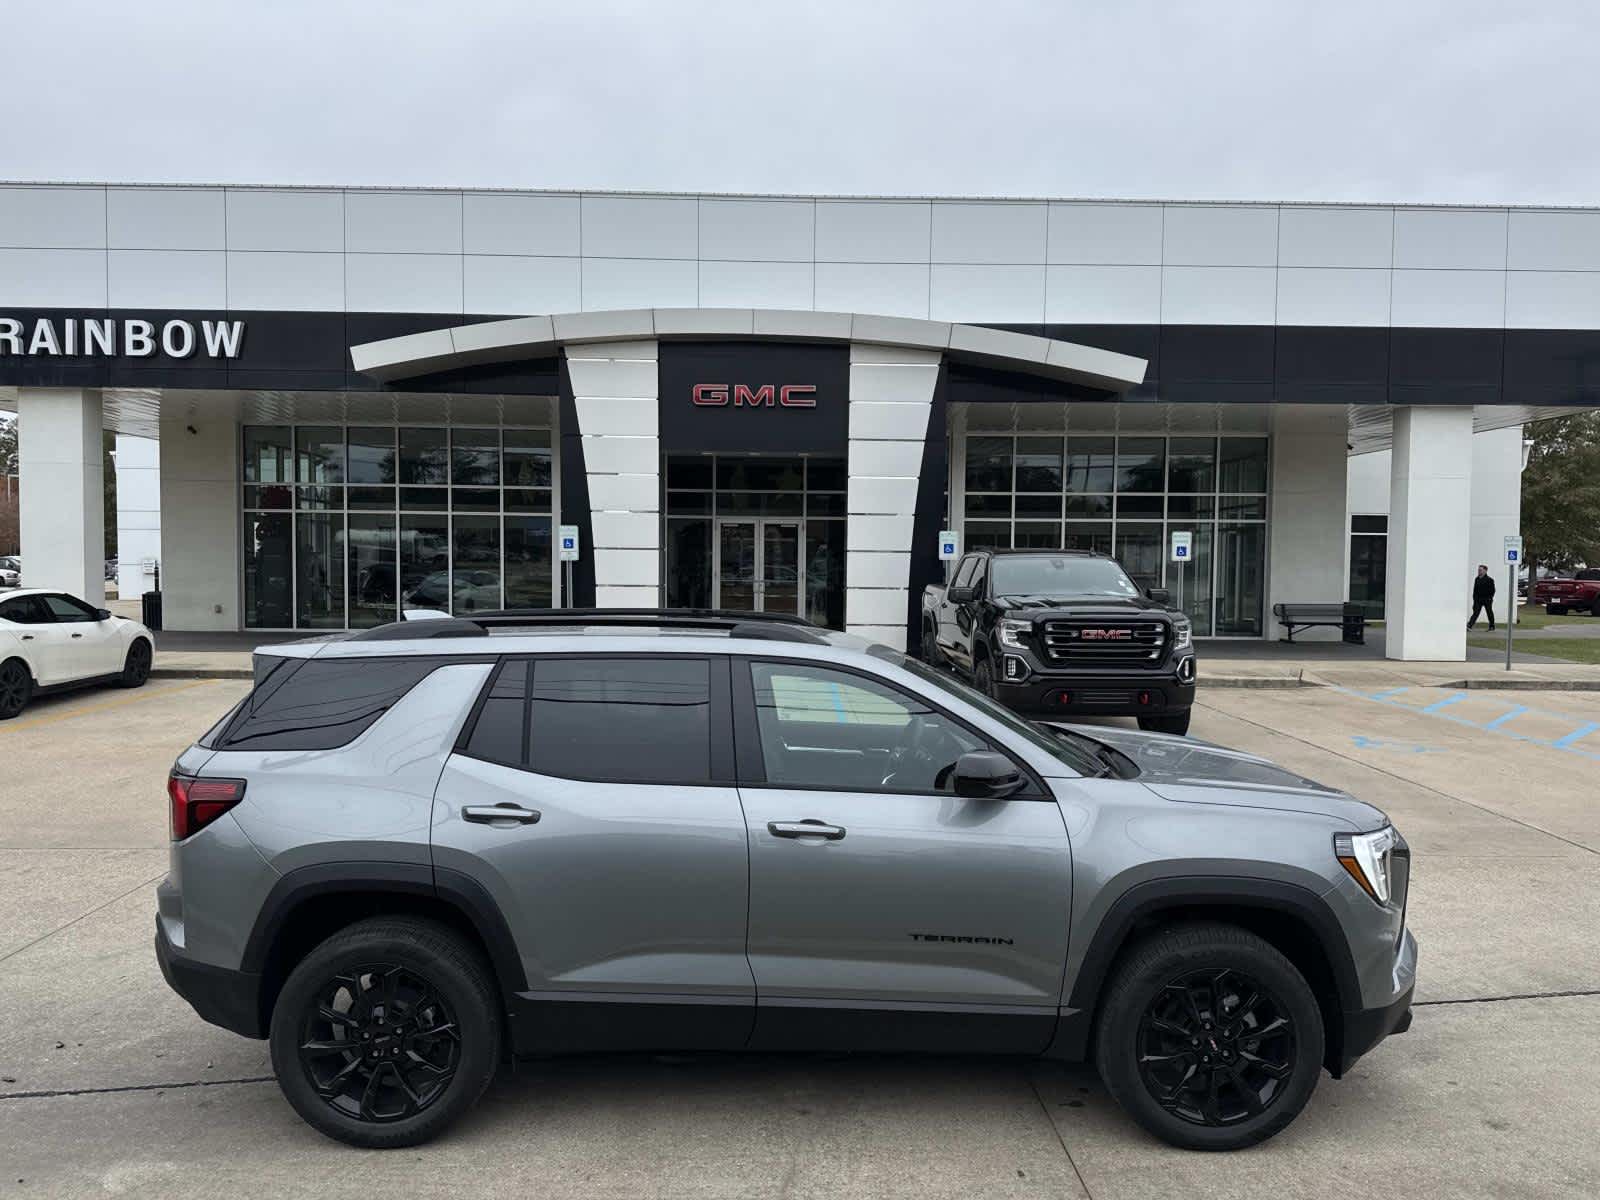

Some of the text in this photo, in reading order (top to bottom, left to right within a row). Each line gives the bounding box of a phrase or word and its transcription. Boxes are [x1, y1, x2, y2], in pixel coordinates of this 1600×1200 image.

[0, 318, 245, 358] RAINBOW
[692, 384, 817, 407] GMC
[1081, 629, 1132, 640] GMC
[908, 934, 1015, 945] TERRAIN
